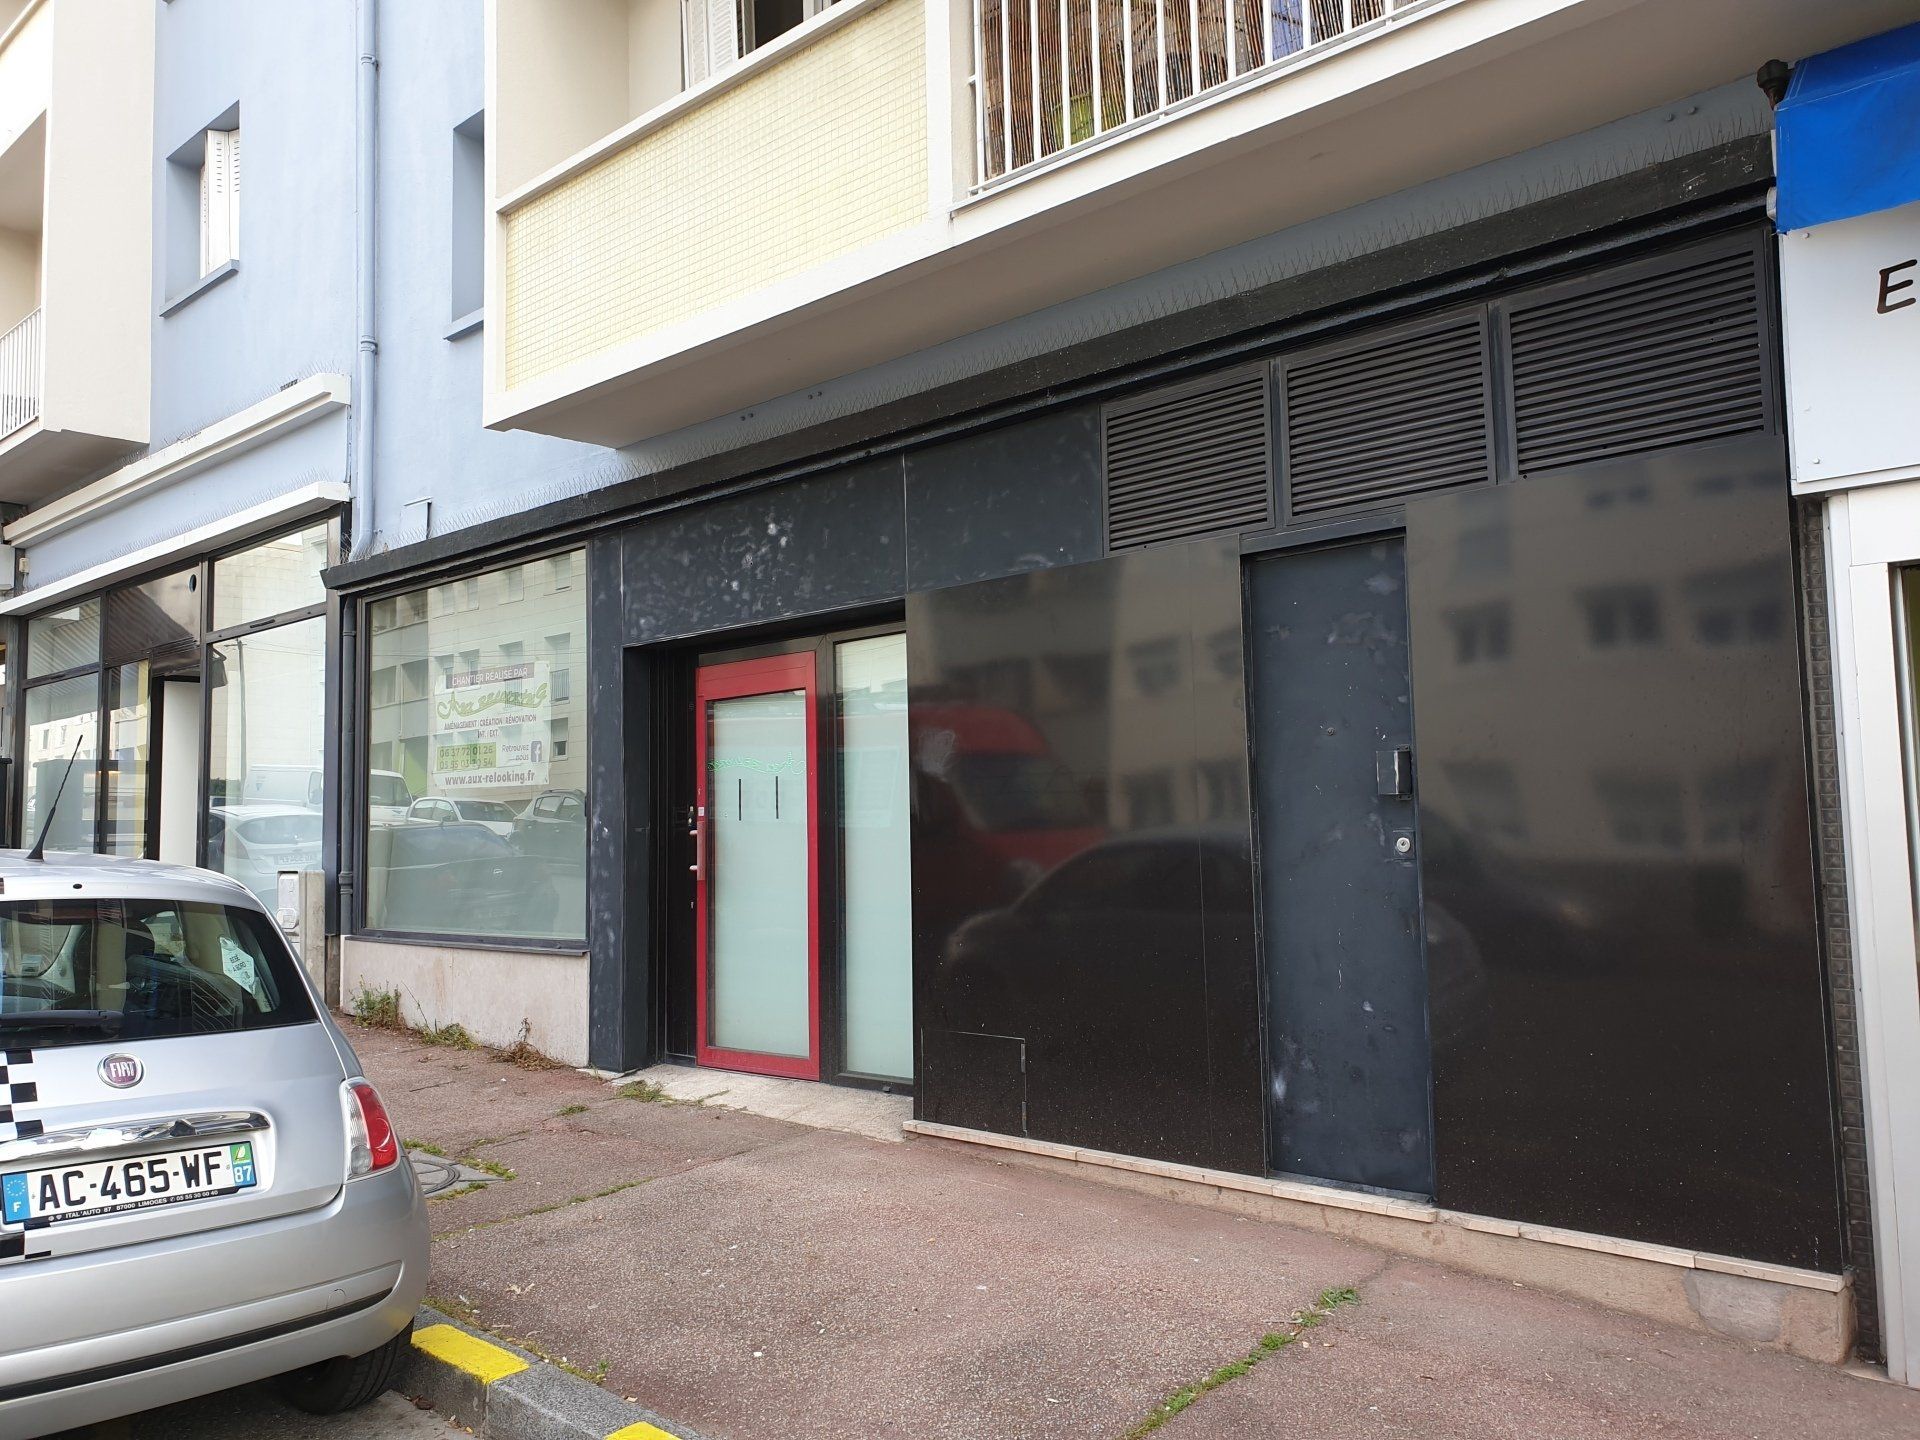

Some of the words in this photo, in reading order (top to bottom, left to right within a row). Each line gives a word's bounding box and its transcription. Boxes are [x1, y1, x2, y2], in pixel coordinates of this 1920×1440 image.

[1877, 259, 1918, 314] E
[452, 673, 484, 686] CHANTIER
[514, 667, 528, 677] PAR
[480, 717, 503, 727] CRÉATION
[505, 714, 537, 725] RÉNOVATION
[445, 770, 535, 785] www.aux-relooking.fr
[110, 1062, 135, 1078] FIAT
[39, 1151, 222, 1211] AC-465-WF
[233, 1165, 252, 1184] 87
[13, 1202, 22, 1213] F
[116, 1203, 136, 1211] 87000
[138, 1198, 168, 1207] LIMOGES
